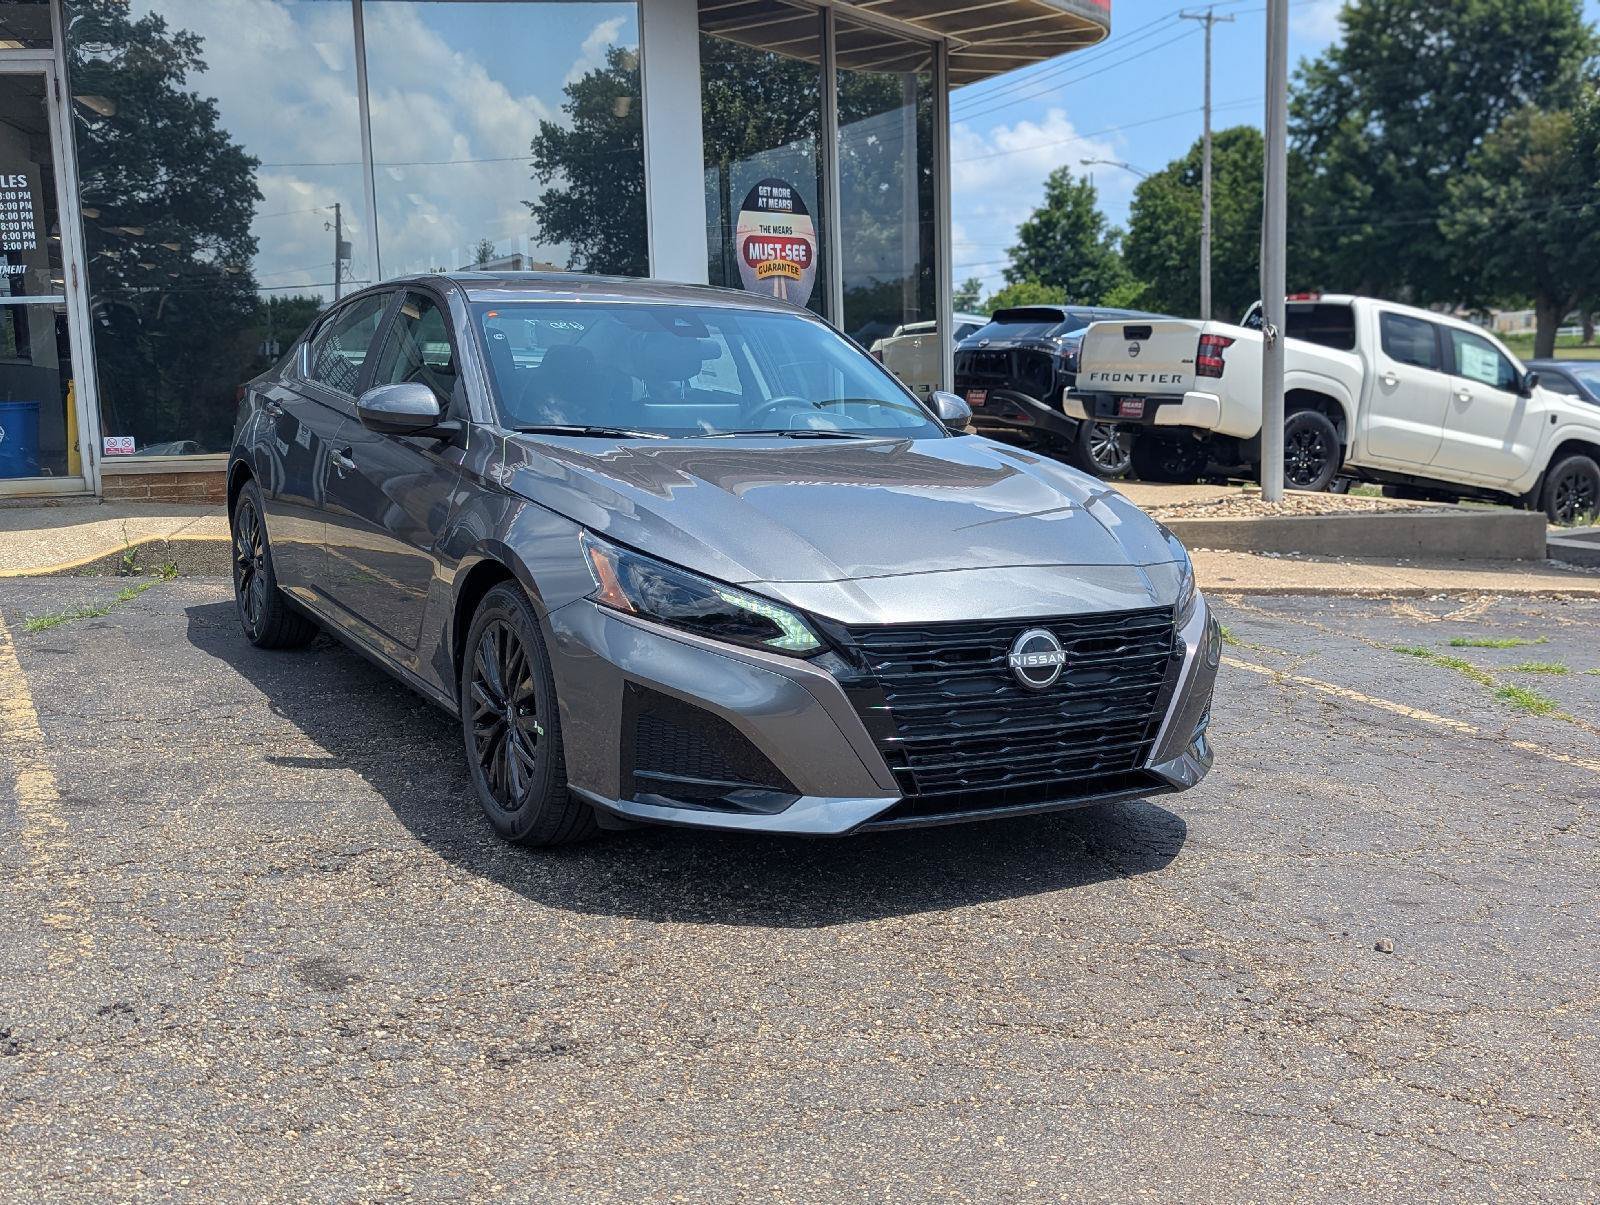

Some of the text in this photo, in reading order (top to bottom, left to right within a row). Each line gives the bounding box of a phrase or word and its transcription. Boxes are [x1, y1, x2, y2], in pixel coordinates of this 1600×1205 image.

[18, 191, 31, 200] PM
[758, 186, 791, 198] GET MORE
[19, 201, 33, 210] PM
[758, 197, 767, 208] AT
[0, 211, 34, 221] 6:00 PM
[0, 221, 35, 231] 8:00 PM
[759, 224, 793, 236] THE MEARS
[1, 231, 36, 241] 6:00 PM
[23, 240, 37, 250] PM
[749, 243, 807, 261] MUST-SEE
[758, 262, 800, 276] GUARANTEE
[1090, 373, 1182, 384] FRONTIER
[1010, 653, 1065, 666] NISSAN
